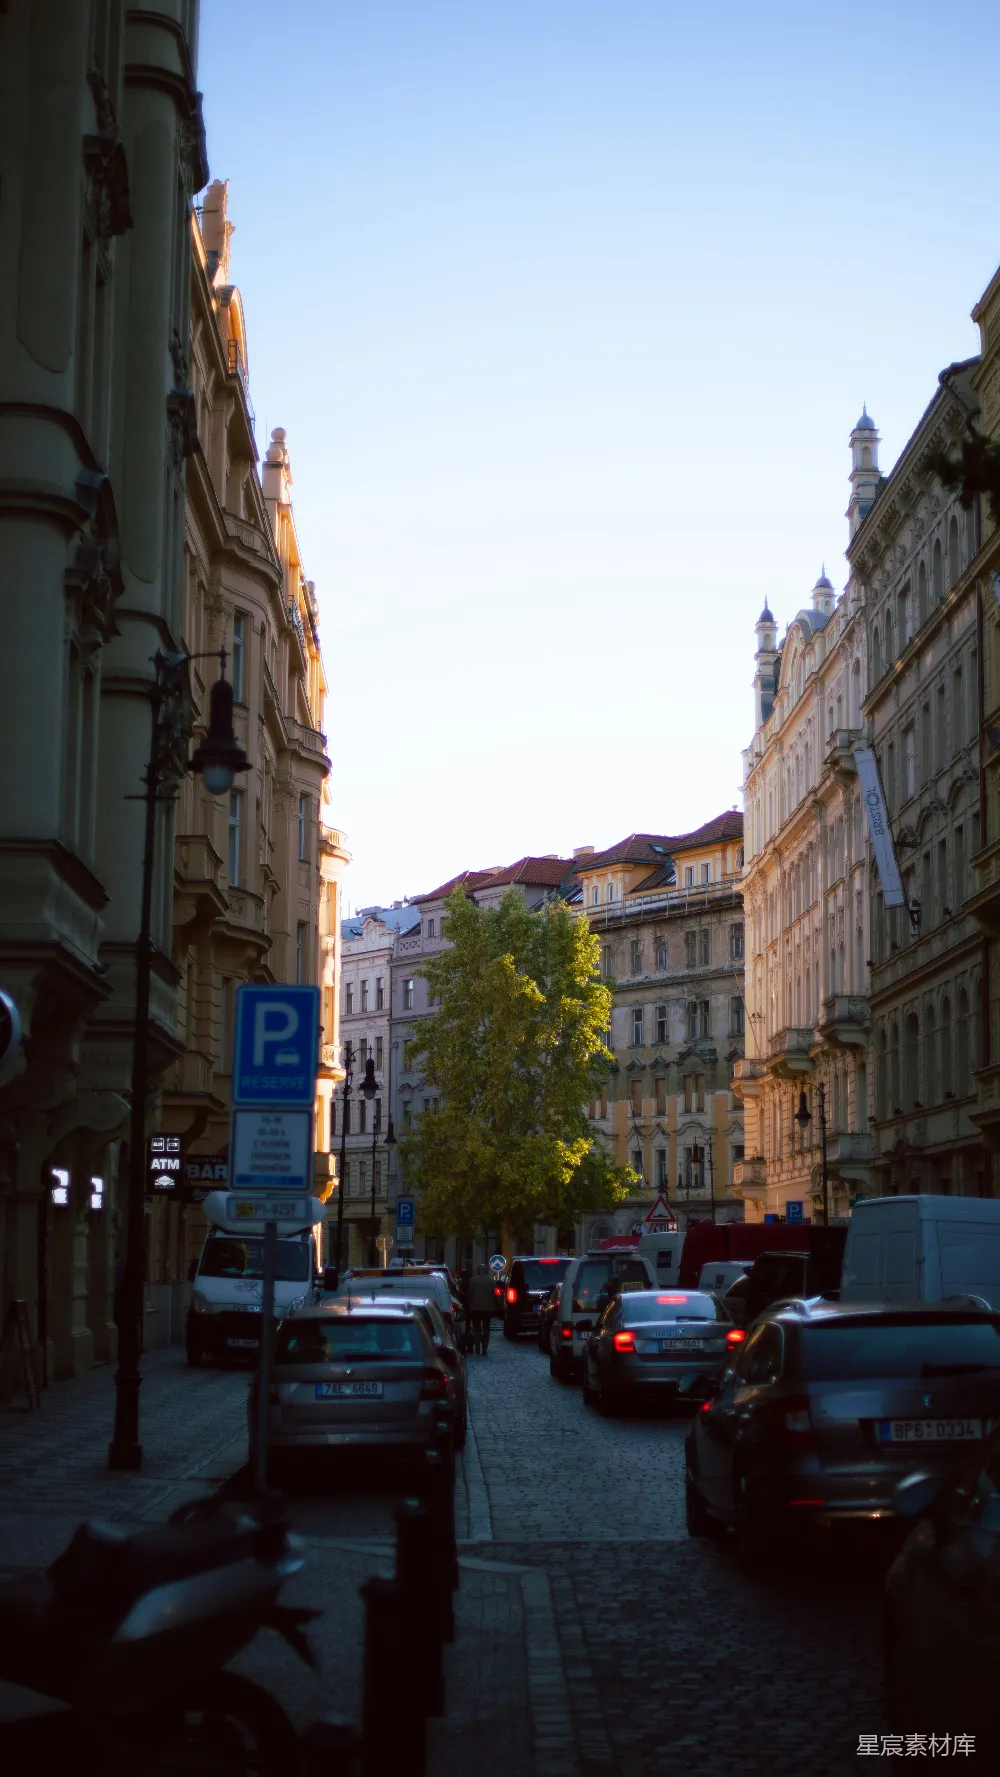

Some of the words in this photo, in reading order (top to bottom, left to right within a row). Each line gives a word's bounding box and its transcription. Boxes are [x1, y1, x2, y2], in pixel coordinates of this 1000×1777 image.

[866, 786, 885, 836] BRISTOL
[252, 1001, 300, 1067] P
[150, 1158, 180, 1170] ATM
[186, 1163, 228, 1180] BAR
[324, 1383, 345, 1395] 7AE
